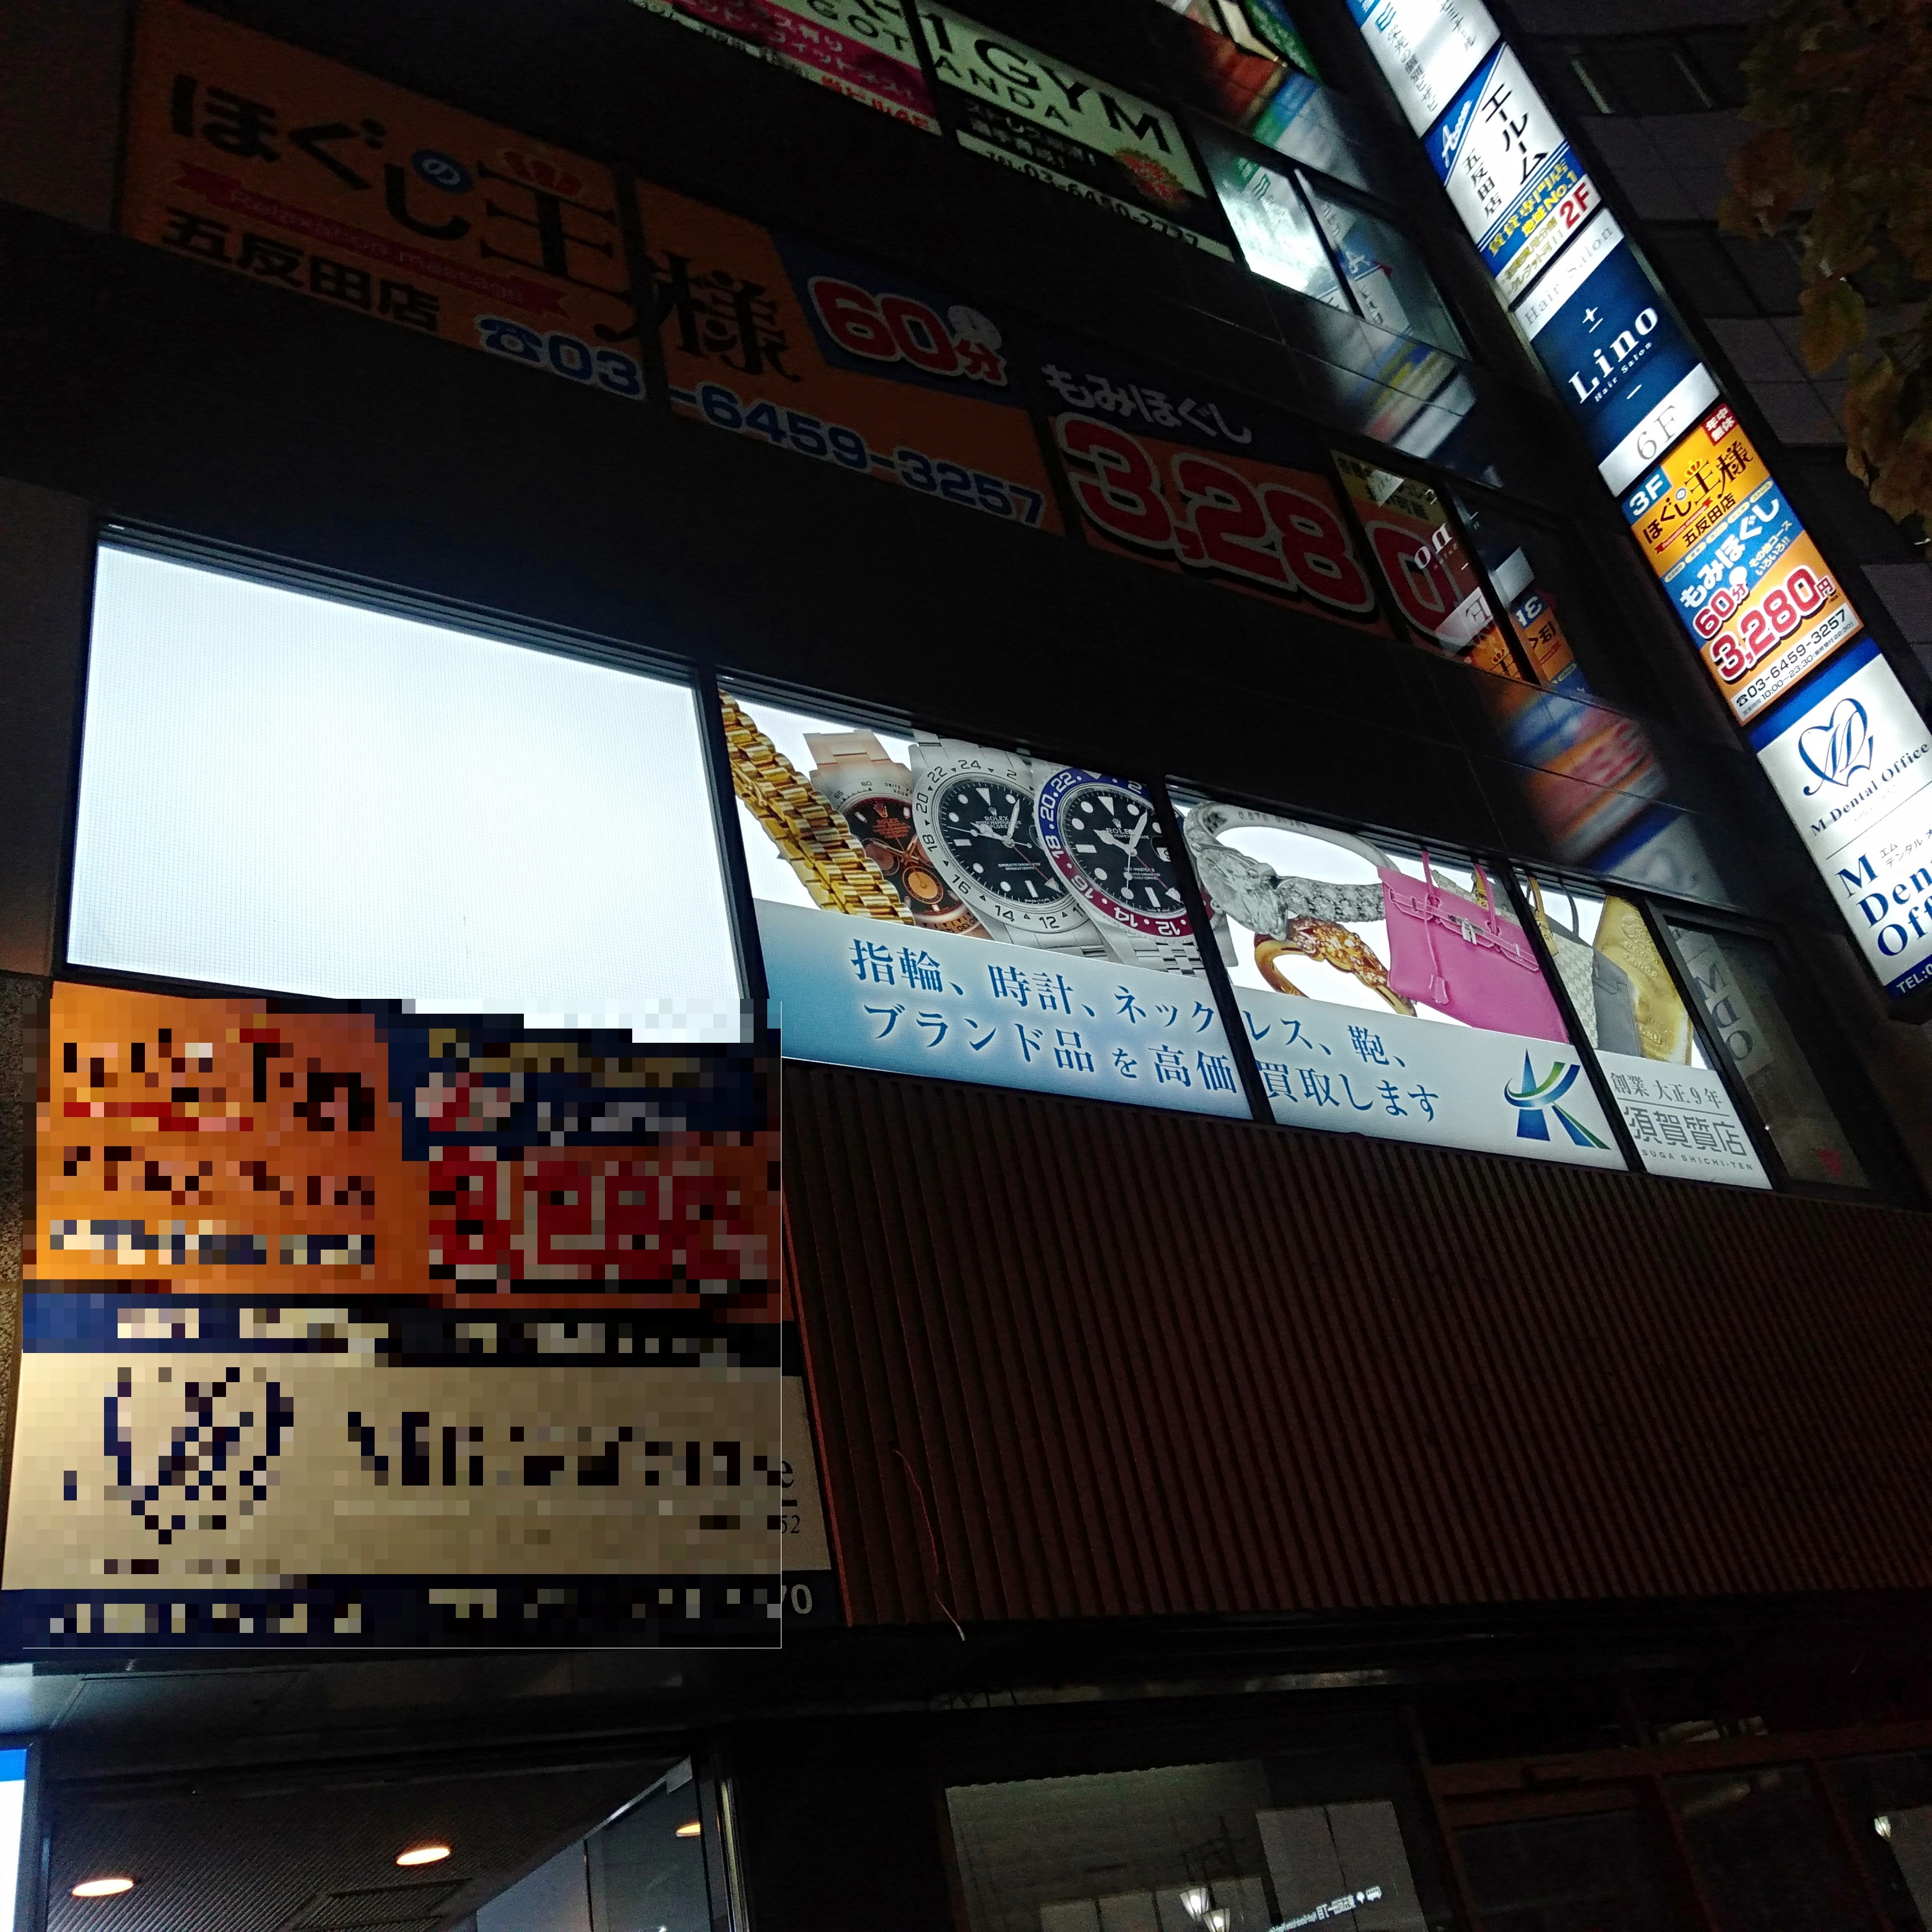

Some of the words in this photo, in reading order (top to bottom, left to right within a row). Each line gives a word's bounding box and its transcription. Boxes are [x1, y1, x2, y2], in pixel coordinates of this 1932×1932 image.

[975, 40, 1173, 154] GYM
[1481, 83, 1549, 186] エルーム
[1462, 147, 1502, 219] 五反田店
[1559, 181, 1590, 231] 2F
[162, 206, 440, 332] 五反田店
[1525, 284, 1559, 326] Hair
[1568, 307, 1658, 404] Lino
[1594, 376, 1617, 402] Hair
[1621, 342, 1652, 373] Salon
[1040, 364, 1253, 445] もみほぐし
[1637, 405, 1676, 460] 6F
[1629, 474, 1663, 516] 3F
[1643, 440, 1754, 545] ほぐしの王様
[1682, 492, 1736, 547] 五反田店
[1679, 498, 1780, 609] もみほぐし
[1694, 581, 1748, 638] 60分
[928, 767, 947, 783] 22
[958, 760, 981, 769] 24
[1810, 819, 1827, 836] M
[1829, 780, 1878, 822] Dental
[1881, 744, 1929, 782] Office
[1835, 853, 1881, 899] M
[1880, 843, 1898, 859] エム
[1886, 838, 1923, 868] デンタル
[1611, 1072, 1650, 1097] 創業
[1624, 1107, 1747, 1157] 須賀質店
[1642, 1149, 1675, 1160] SUGA
[1682, 1155, 1753, 1171] SHICHI-TEN
